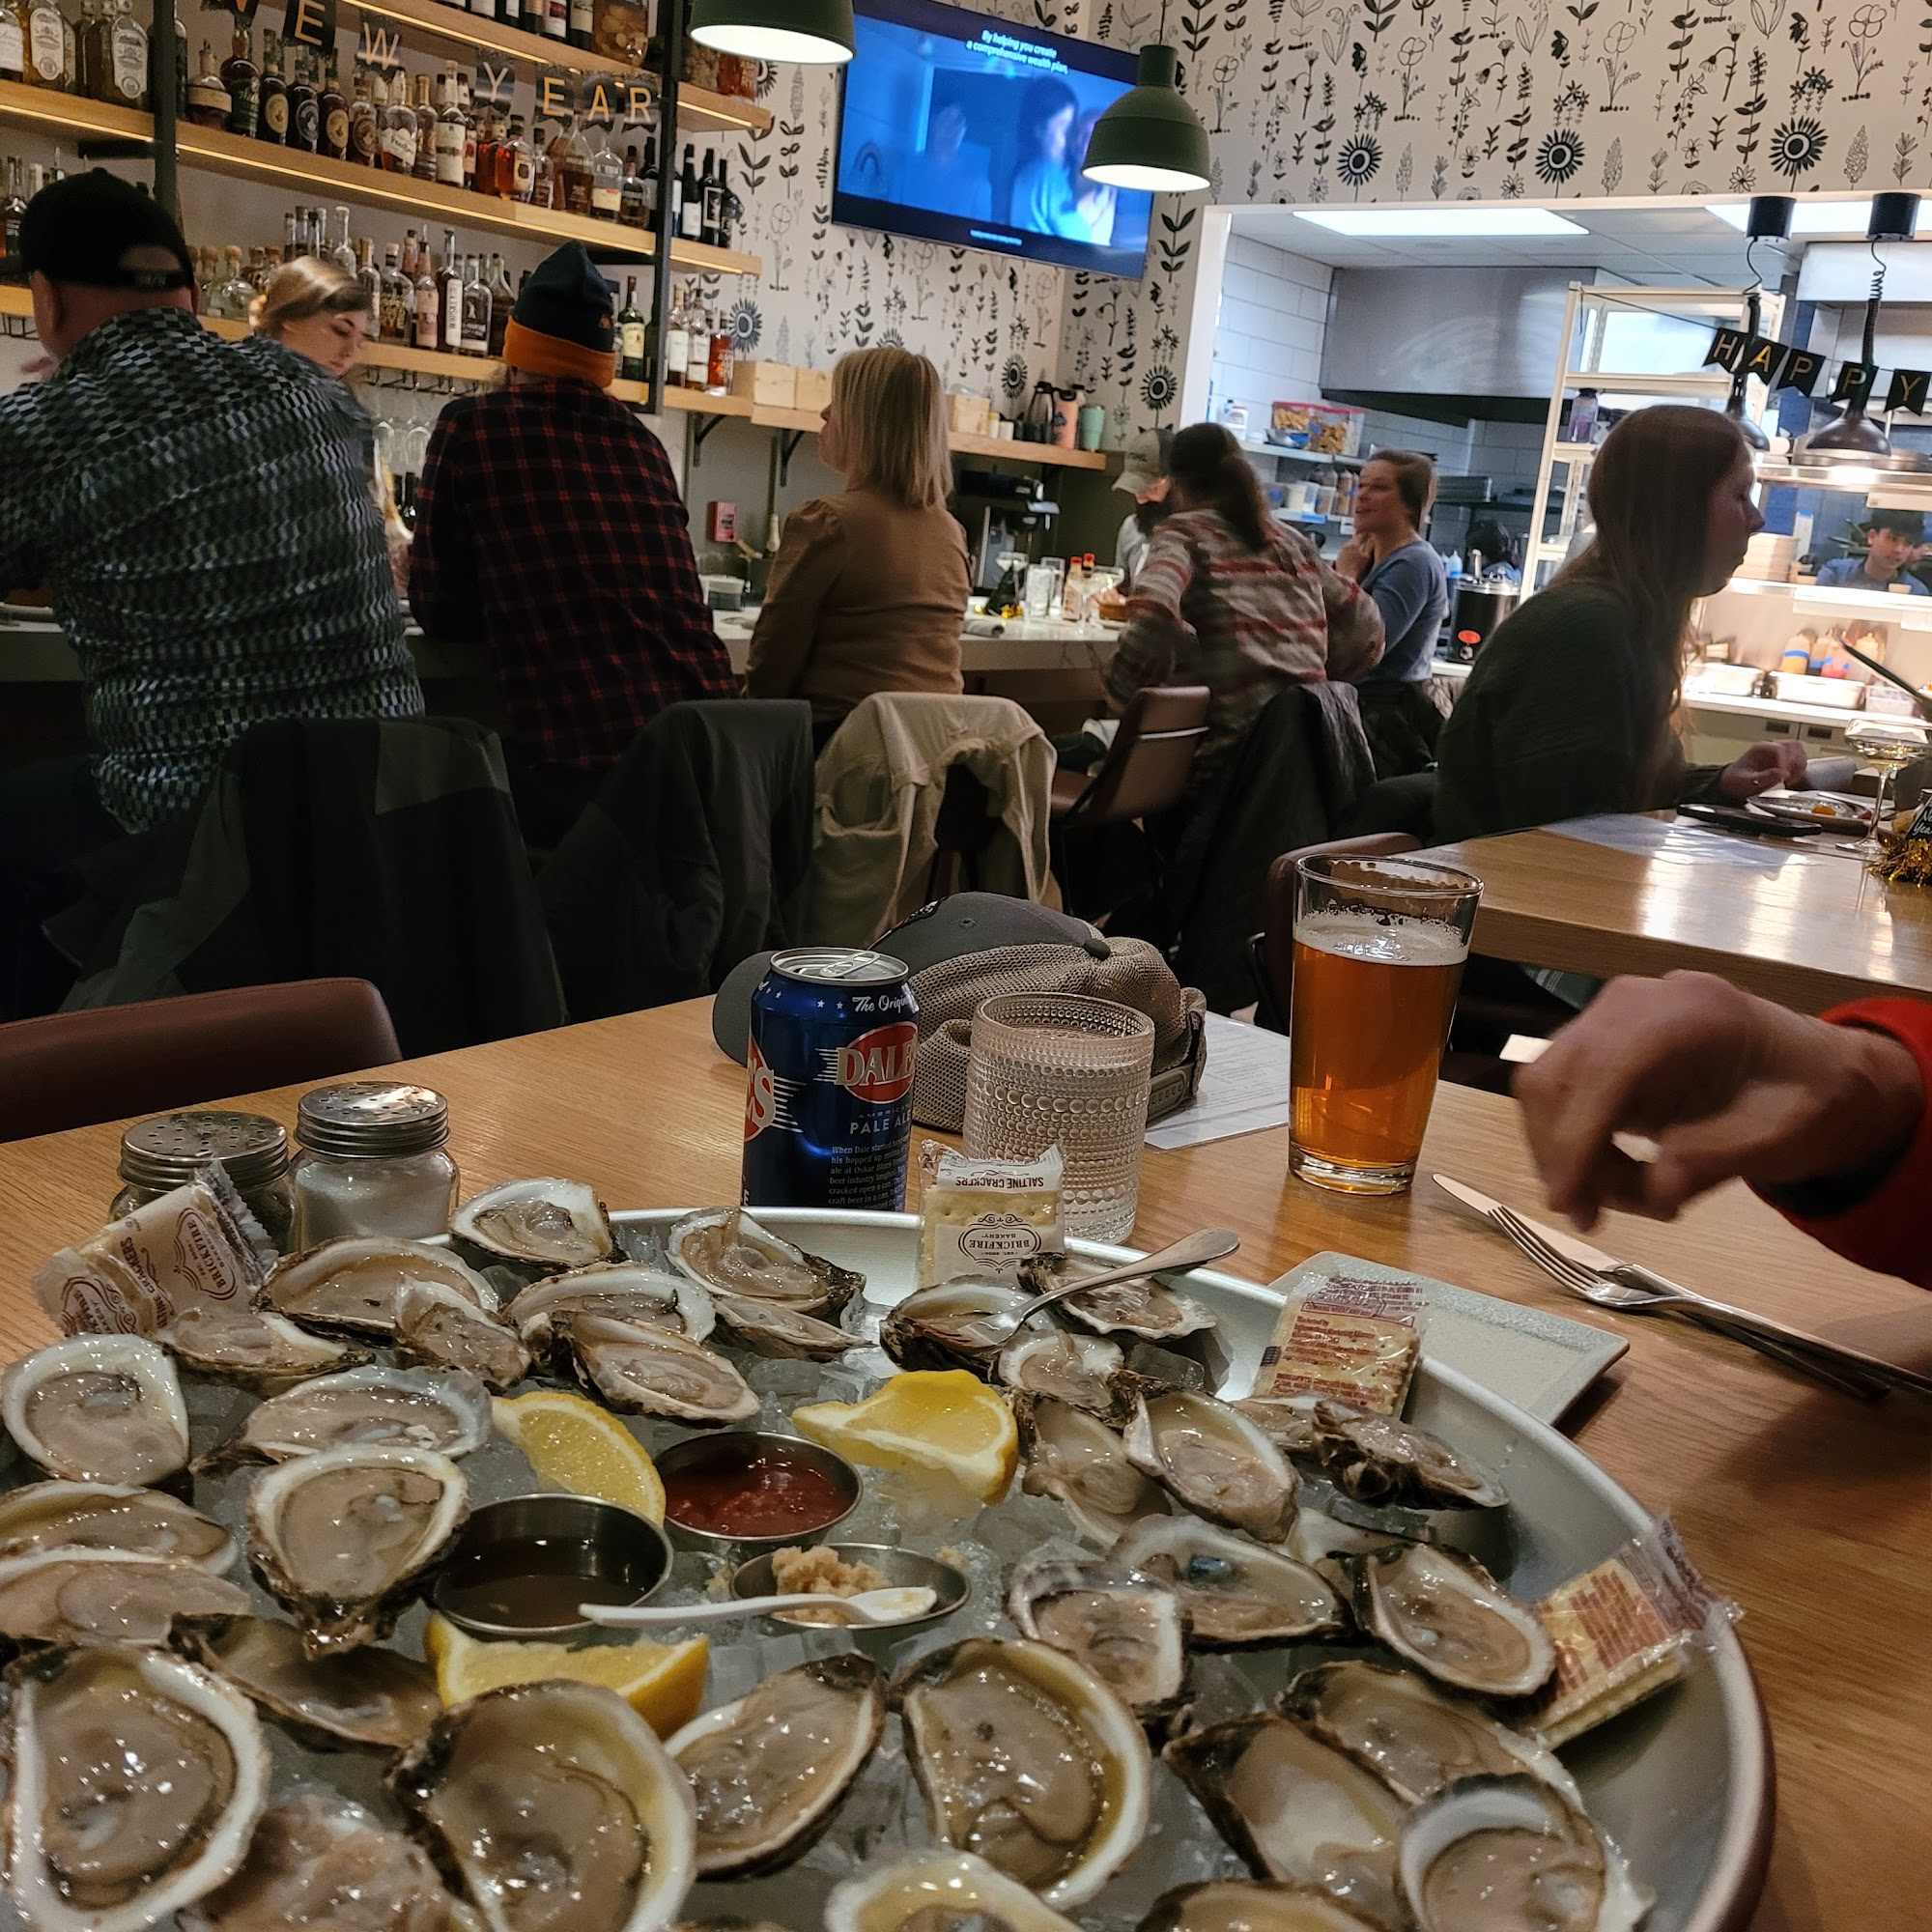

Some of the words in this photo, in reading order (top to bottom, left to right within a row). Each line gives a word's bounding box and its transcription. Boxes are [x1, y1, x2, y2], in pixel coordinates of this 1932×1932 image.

[483, 62, 652, 123] YEAR
[1713, 333, 1922, 402] HAPPY
[852, 996, 875, 1012] The
[850, 1119, 890, 1135] PALE
[895, 1110, 911, 1128] ALE
[832, 1146, 853, 1154] When
[845, 1156, 872, 1166] hopped
[847, 1175, 874, 1185] industry
[1007, 1178, 1043, 1188] SALTINE
[829, 1186, 858, 1195] cracked
[859, 1184, 875, 1194] open
[847, 1195, 864, 1204] beer
[969, 1239, 1031, 1250] BRICKFIRE
[186, 1219, 227, 1290] BRICKFIRE
[120, 1236, 156, 1294] CRACKERS
